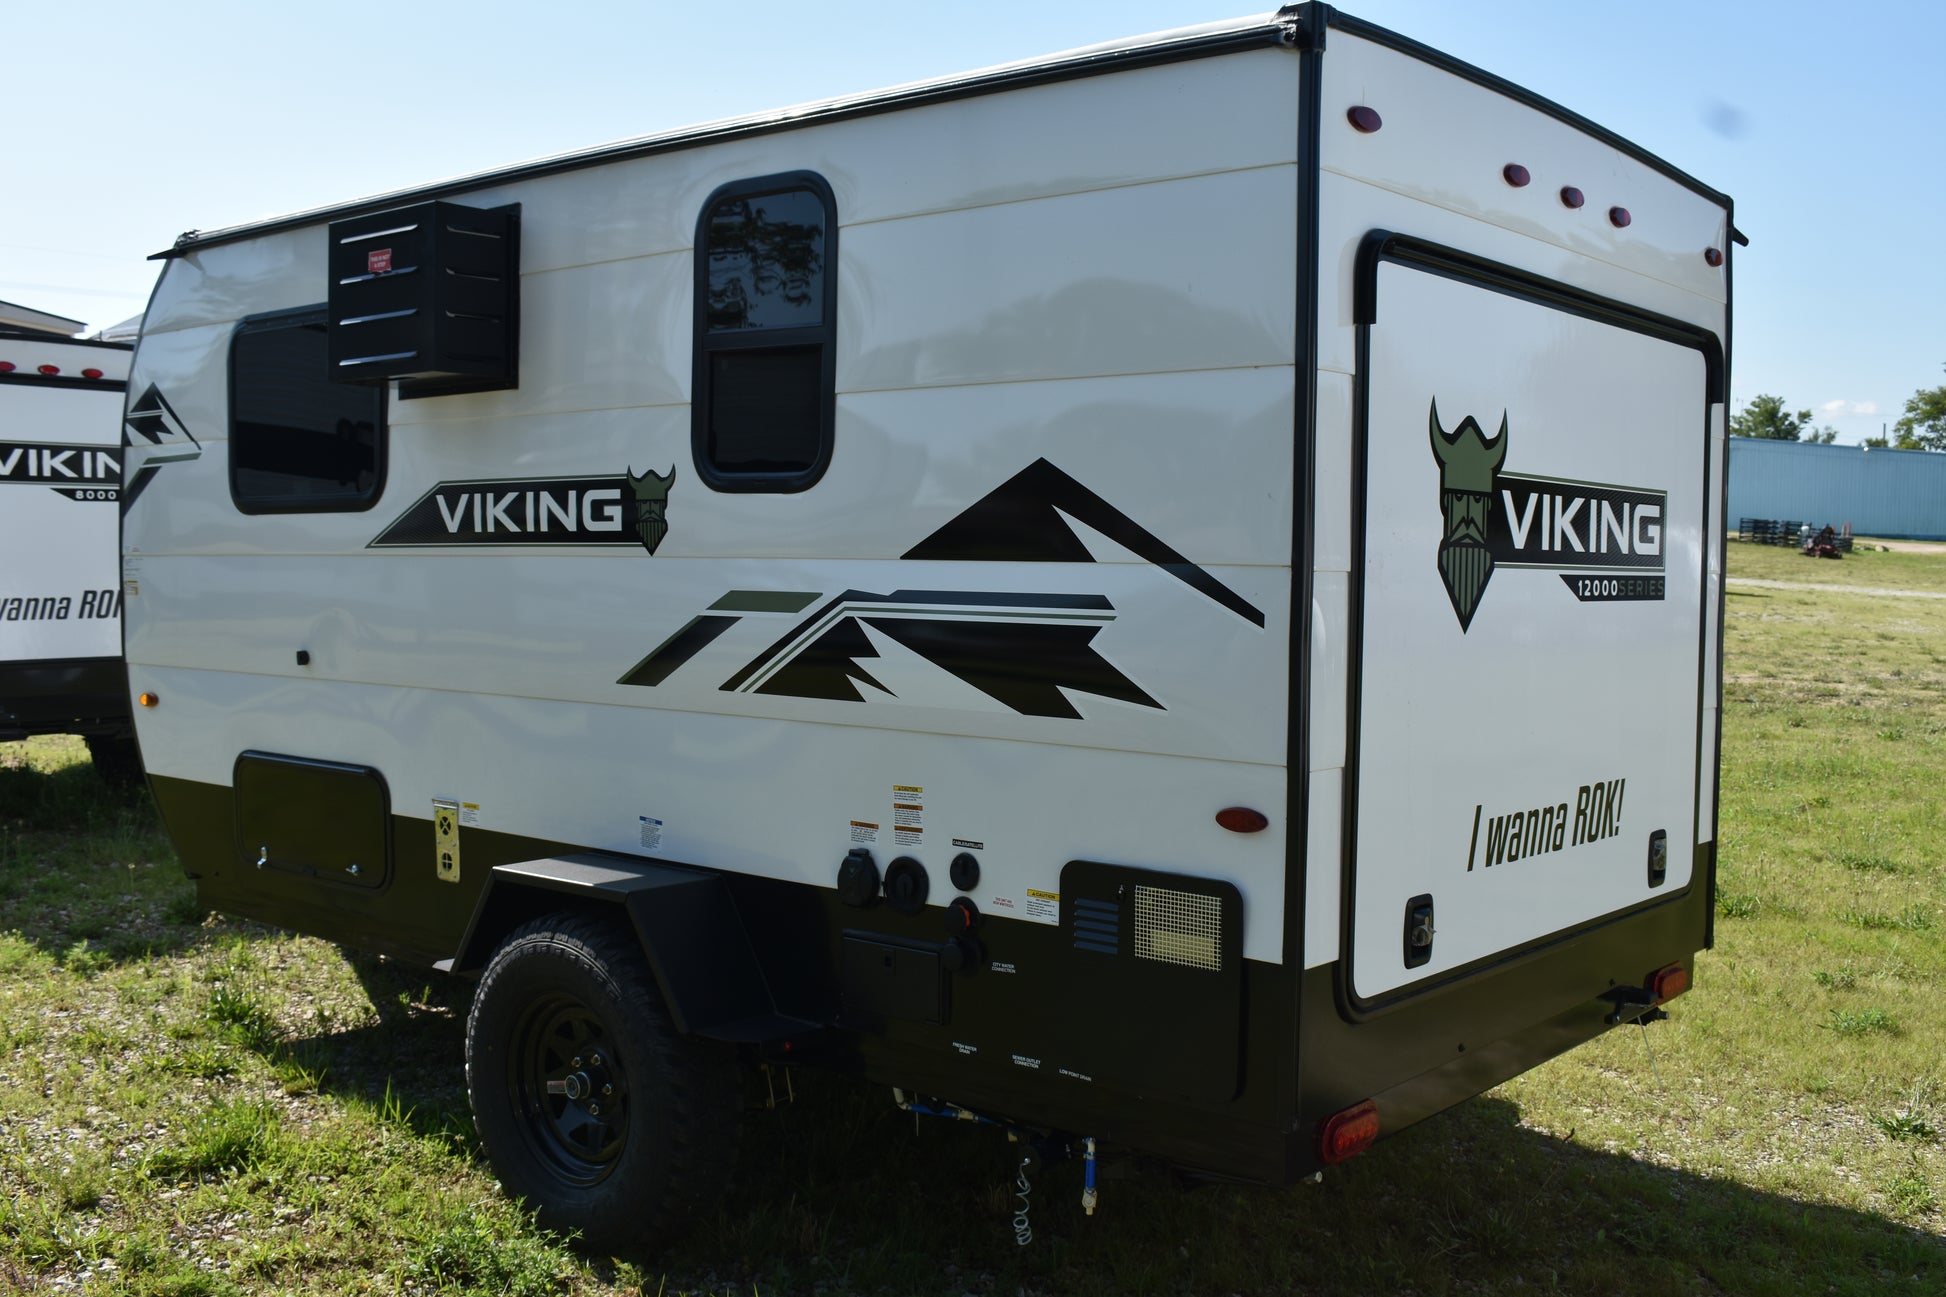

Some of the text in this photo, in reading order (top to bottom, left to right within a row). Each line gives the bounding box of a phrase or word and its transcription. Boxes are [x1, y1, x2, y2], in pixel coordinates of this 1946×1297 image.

[75, 490, 117, 500] 8000
[435, 489, 622, 533] VIKING
[1502, 489, 1660, 555] VIKING
[1467, 778, 1626, 872] I wanna ROK!
